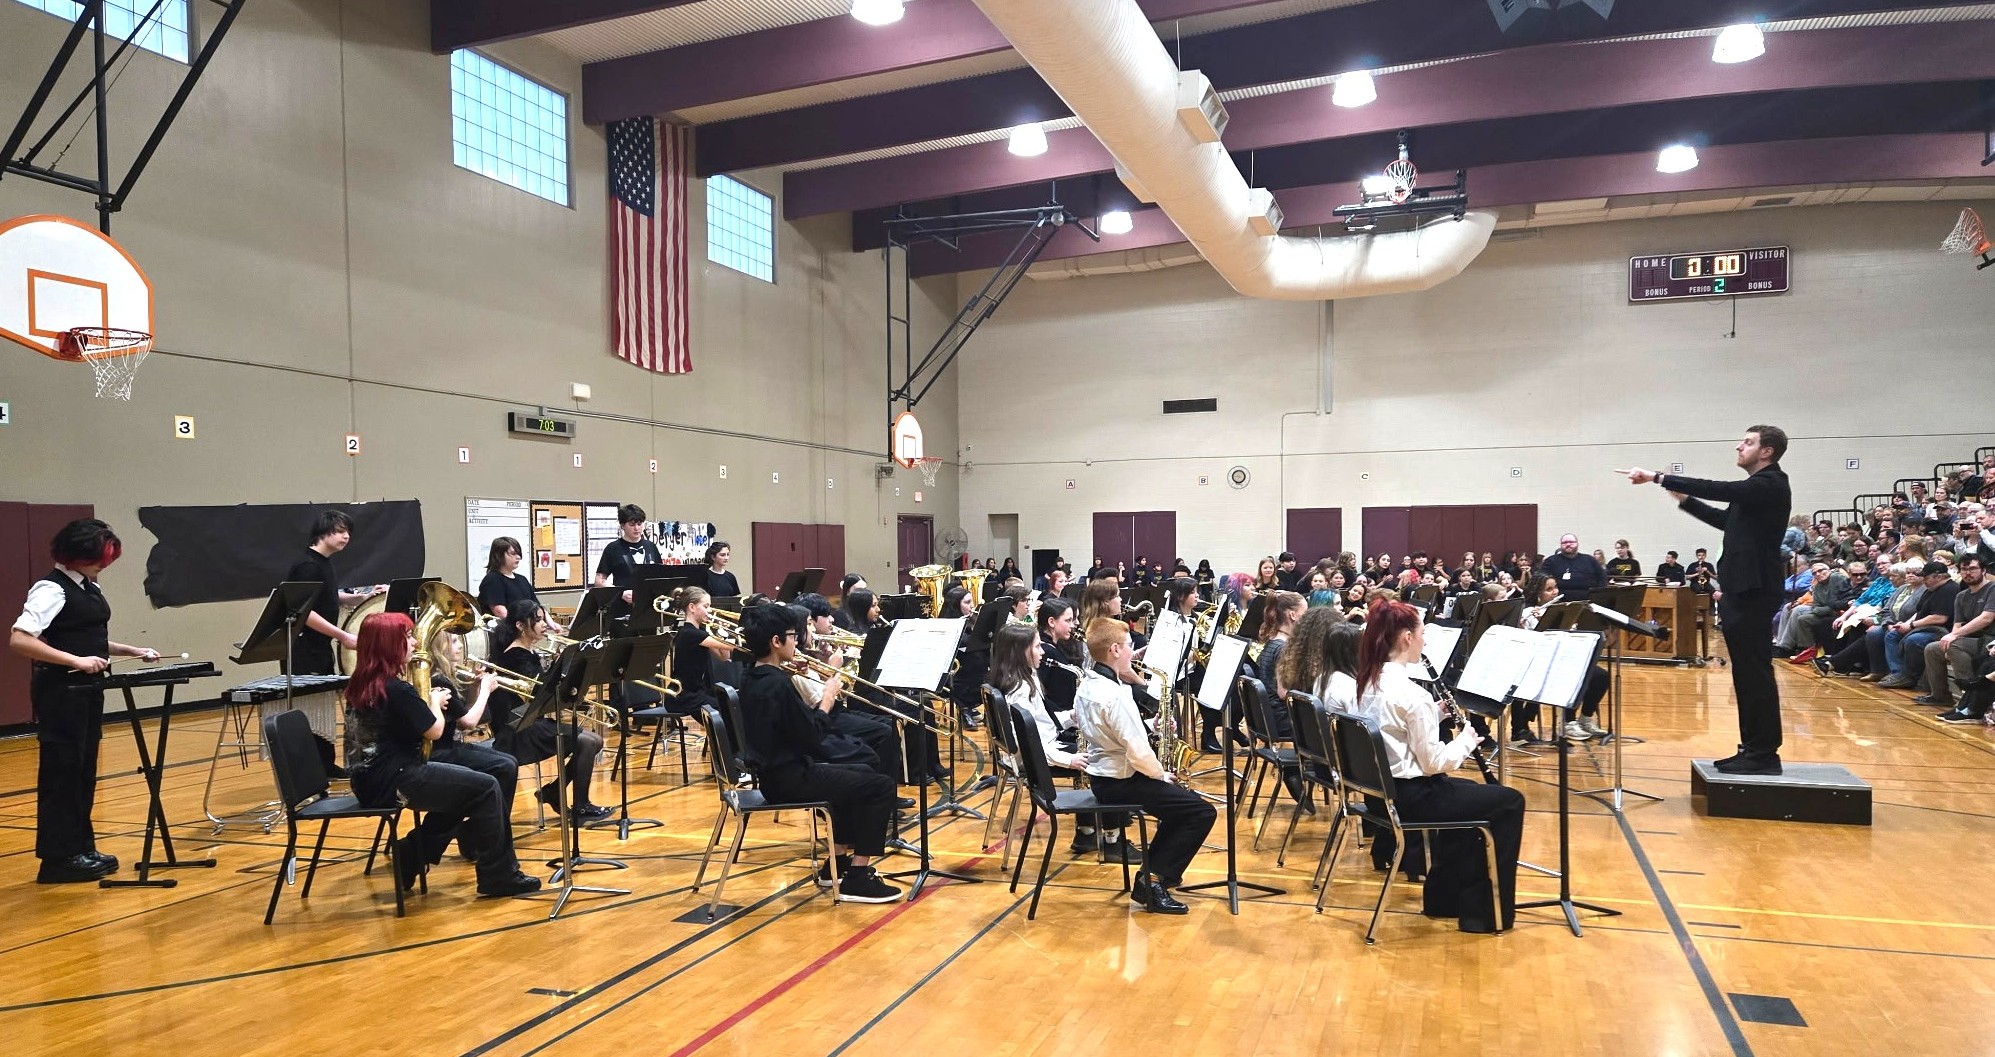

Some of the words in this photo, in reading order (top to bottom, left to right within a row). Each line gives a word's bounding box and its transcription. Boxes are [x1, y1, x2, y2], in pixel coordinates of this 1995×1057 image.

[1749, 249, 1785, 260] VISITOR
[1635, 258, 1666, 268] HOME
[1689, 285, 1711, 293] PERIOD
[1714, 278, 1725, 292] 2
[1748, 281, 1773, 290] BONUS
[1645, 287, 1668, 297] BONUS
[179, 421, 191, 434] 3
[349, 439, 358, 450] 2
[461, 450, 466, 460] 1
[651, 462, 656, 470] 2
[720, 468, 725, 476] 3
